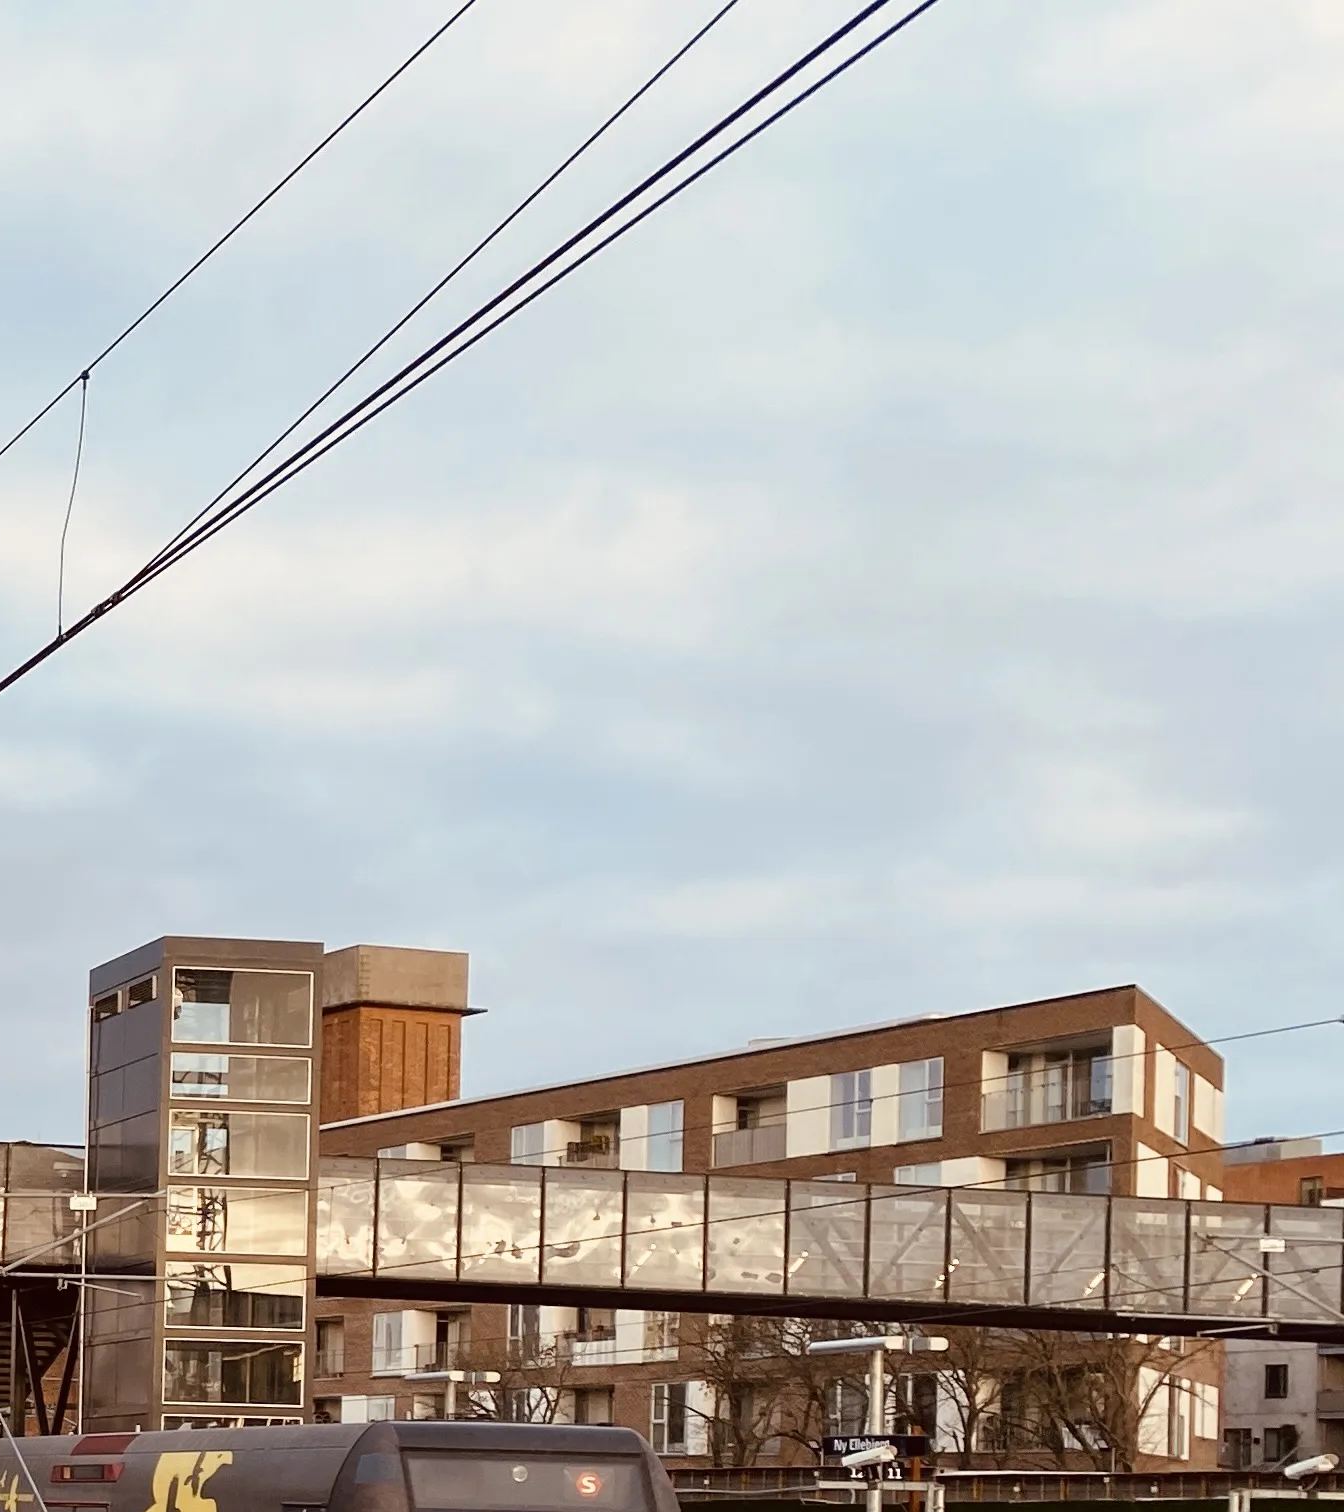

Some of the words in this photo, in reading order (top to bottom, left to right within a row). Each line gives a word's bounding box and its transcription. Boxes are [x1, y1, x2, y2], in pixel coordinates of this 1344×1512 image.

[833, 1439, 848, 1454] Ny
[887, 1467, 903, 1480] 11
[581, 1476, 597, 1494] S
